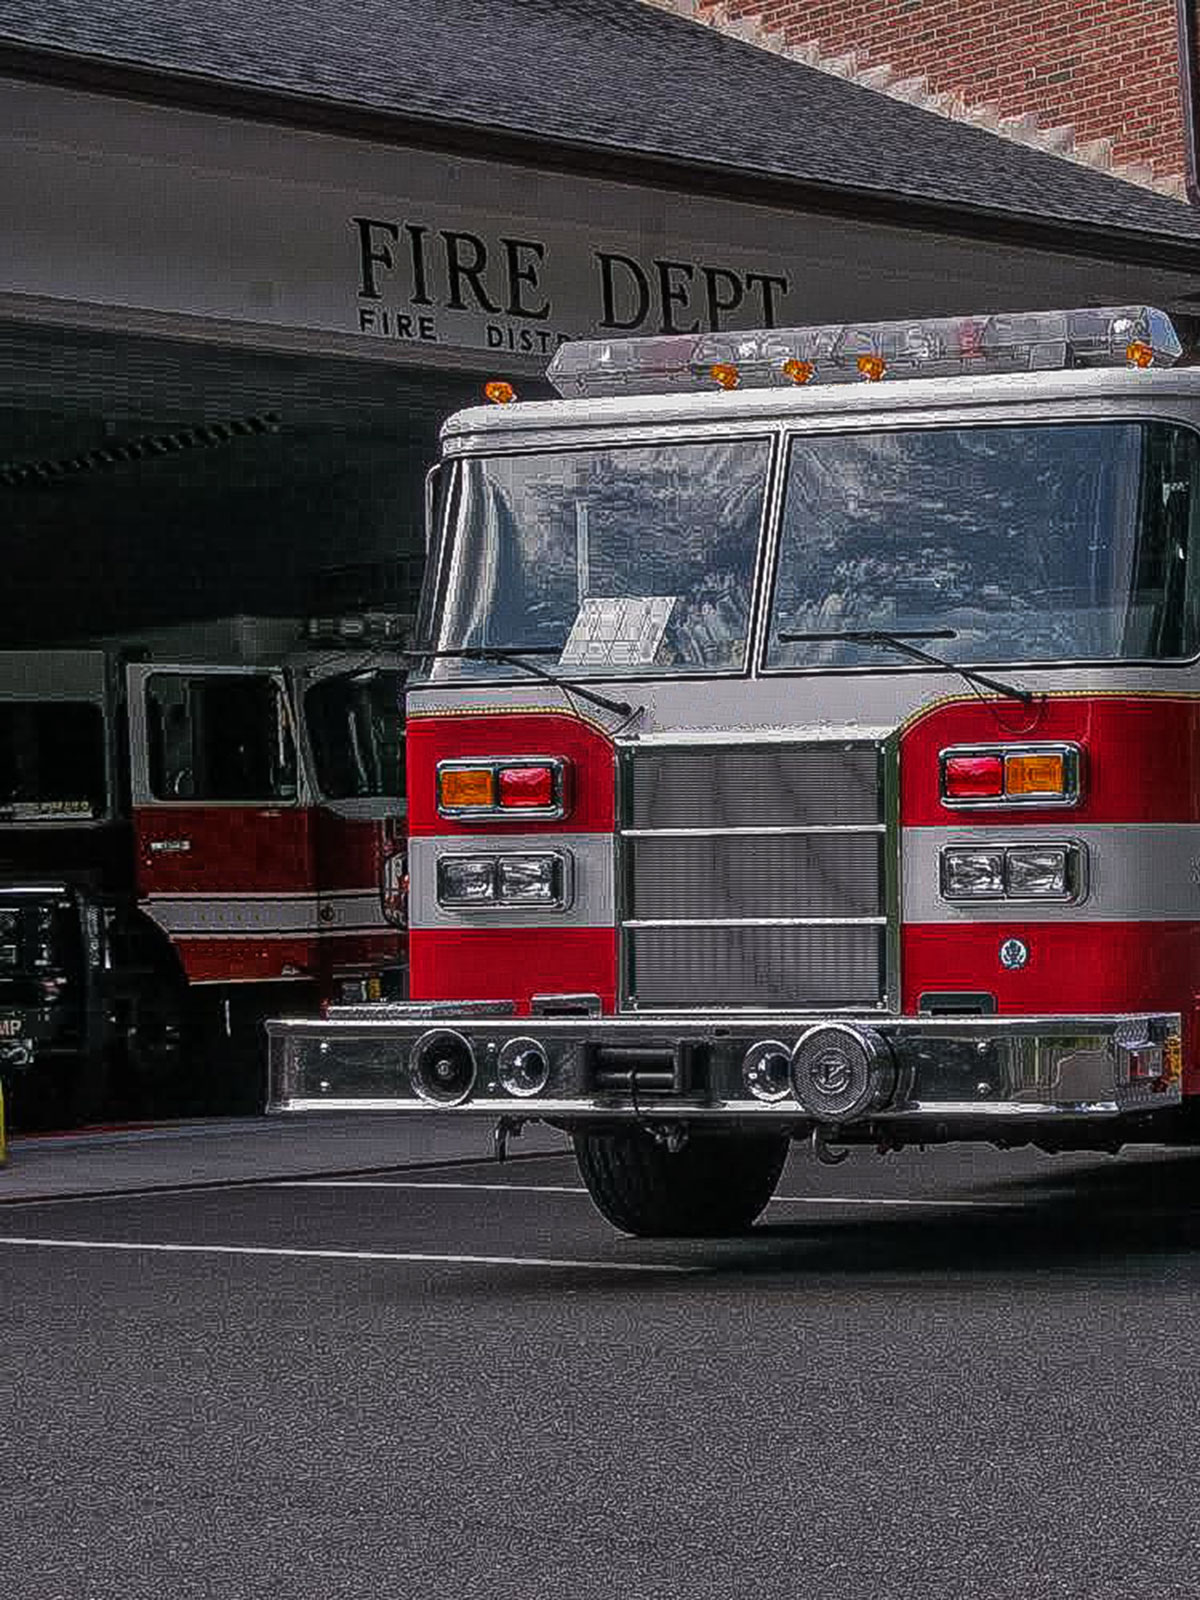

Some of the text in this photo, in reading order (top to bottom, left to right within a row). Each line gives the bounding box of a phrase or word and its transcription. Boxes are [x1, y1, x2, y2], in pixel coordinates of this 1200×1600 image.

[352, 217, 788, 334] FIRE DEPT
[358, 309, 437, 340] FIRE
